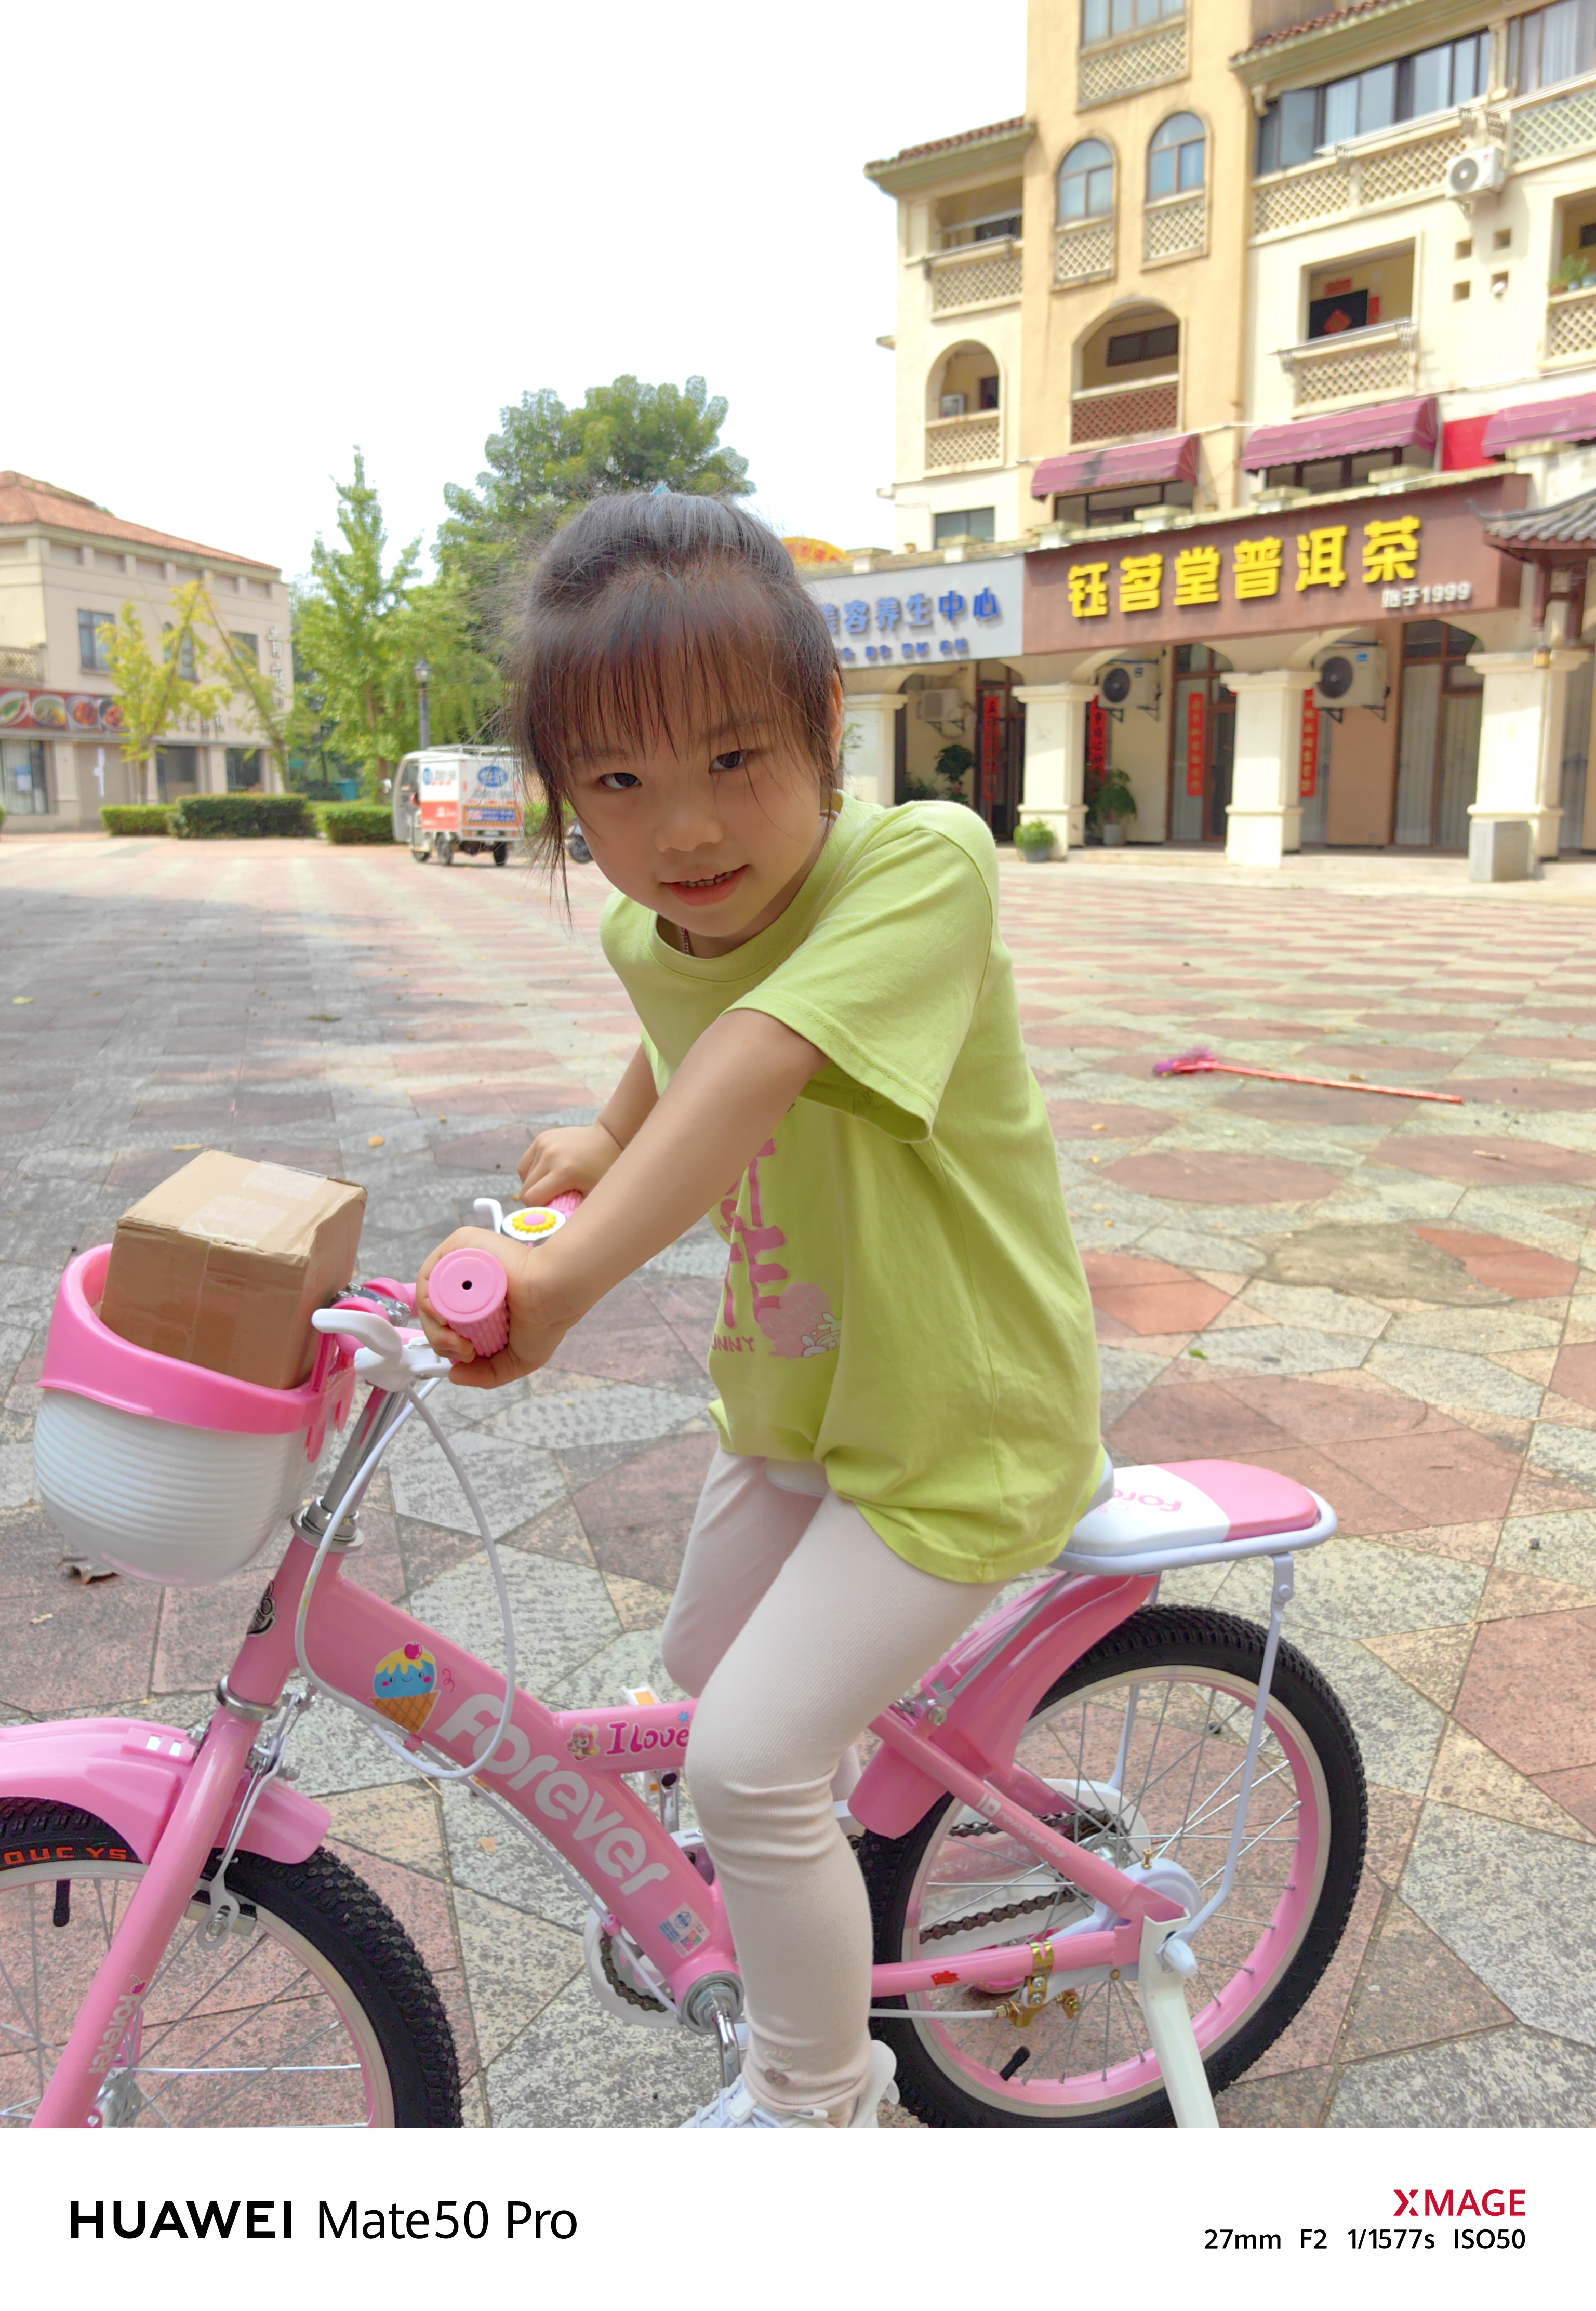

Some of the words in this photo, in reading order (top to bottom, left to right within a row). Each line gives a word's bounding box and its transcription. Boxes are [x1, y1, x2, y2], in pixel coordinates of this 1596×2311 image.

[1068, 514, 1421, 618] 钰茗堂普洱茶
[1381, 580, 1471, 608] 始于1999
[605, 1720, 628, 1755] I
[629, 1723, 690, 1754] love
